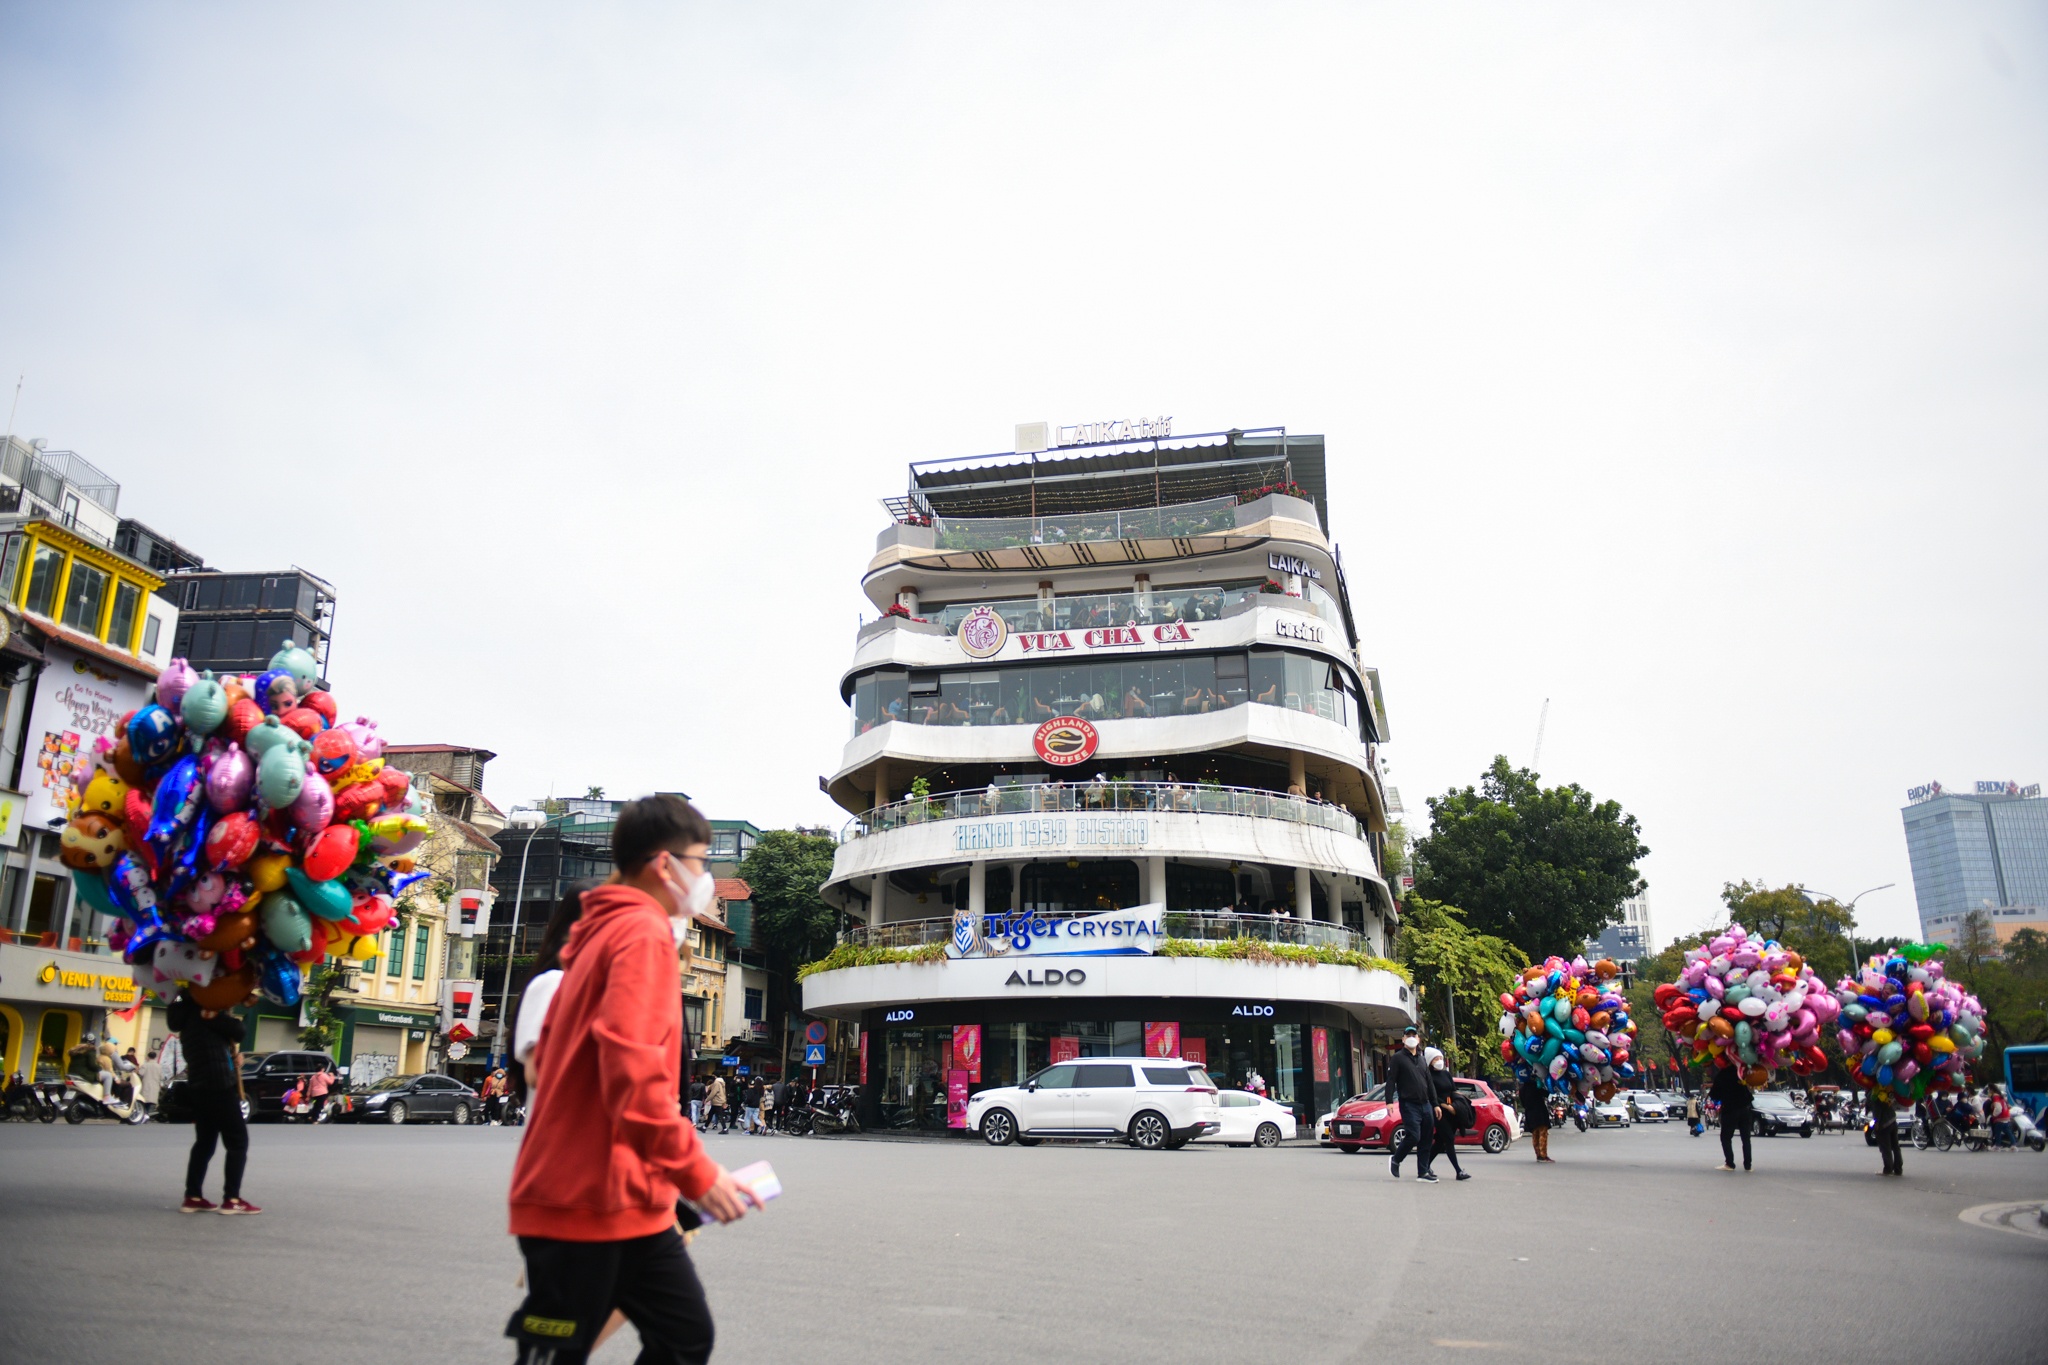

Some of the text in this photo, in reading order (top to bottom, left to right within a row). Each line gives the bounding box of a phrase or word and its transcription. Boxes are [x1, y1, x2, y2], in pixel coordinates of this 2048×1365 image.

[1056, 415, 1174, 448] LAIKA Café
[1268, 552, 1311, 577] LAIKA
[1018, 618, 1194, 652] VUA CHẢ CÁ
[70, 712, 107, 735] 2022
[1036, 718, 1095, 741] HIGHLANDS
[1043, 749, 1089, 763] COFFEE
[1907, 783, 1931, 800] BIDV
[1976, 780, 2006, 793] BIDV
[955, 817, 1149, 850] HANOI 1930 BISTRO
[982, 908, 1164, 950] Tiger CRYSTAL
[60, 971, 97, 987] YENLY
[1004, 968, 1087, 986] ALDO
[104, 991, 136, 1003] DESSERT
[885, 1010, 914, 1022] ALDO
[1231, 1005, 1275, 1017] ALDO
